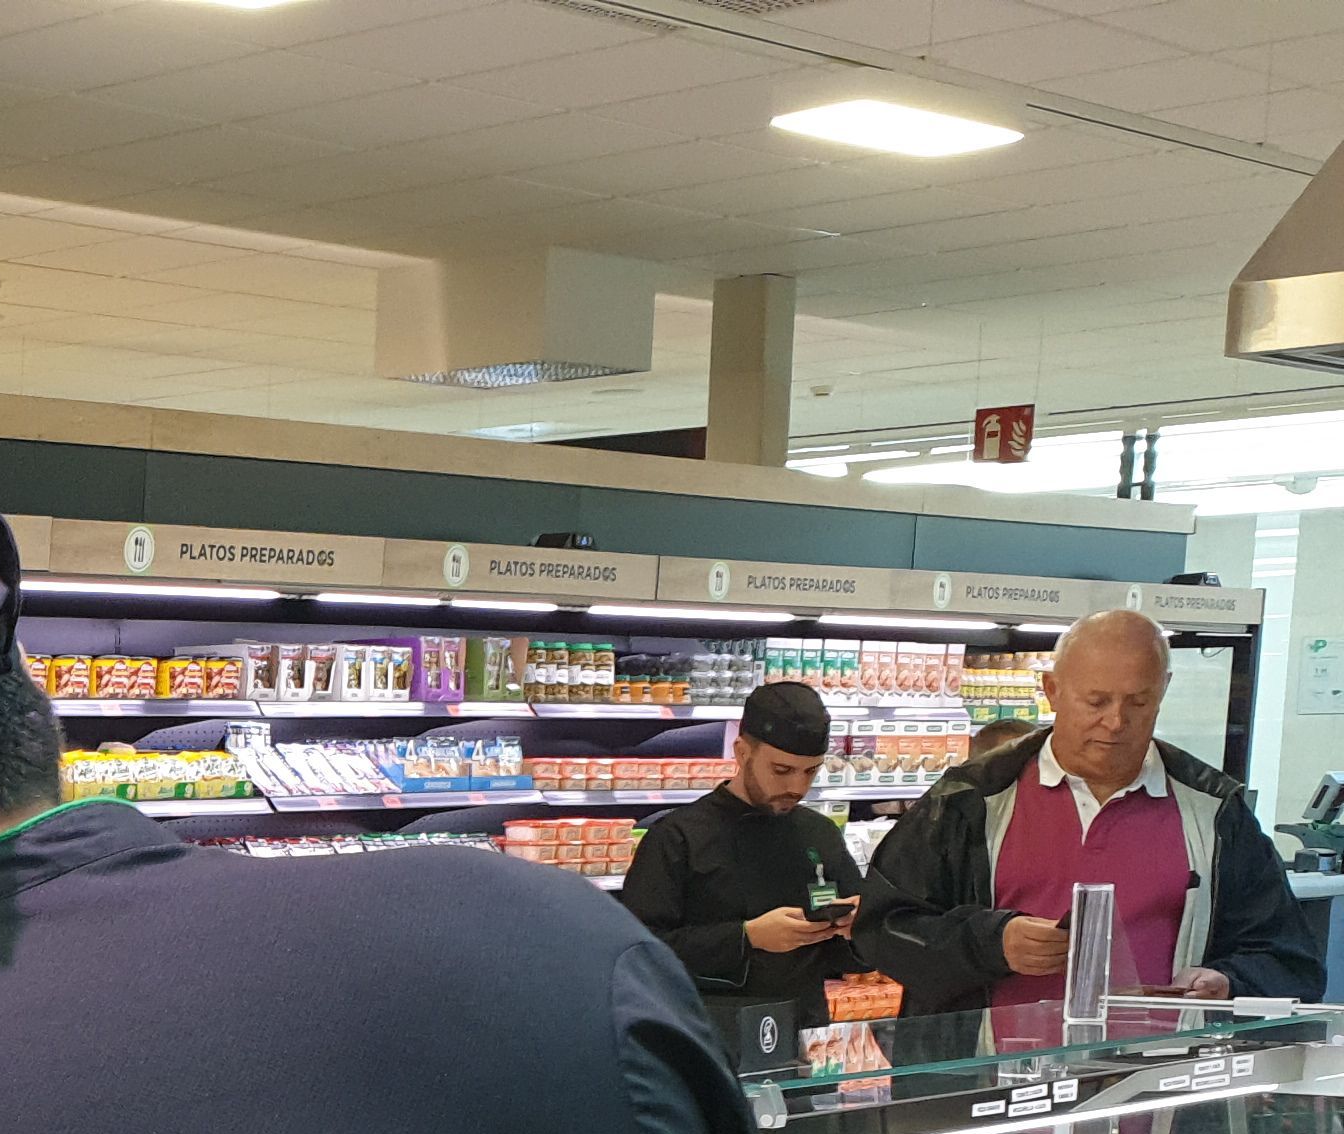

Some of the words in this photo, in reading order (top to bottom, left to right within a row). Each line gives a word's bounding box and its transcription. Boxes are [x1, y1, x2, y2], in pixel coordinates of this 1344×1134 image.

[179, 543, 236, 562] PLATOS
[240, 546, 335, 567] PREPARADOS
[489, 560, 536, 577] PLATOS
[539, 562, 618, 582] PREPARADOS
[747, 575, 787, 591] PLATOS
[789, 577, 857, 594] PREPARADOS
[966, 586, 1000, 600] PLATOS
[1002, 587, 1061, 603] PREPARADOS
